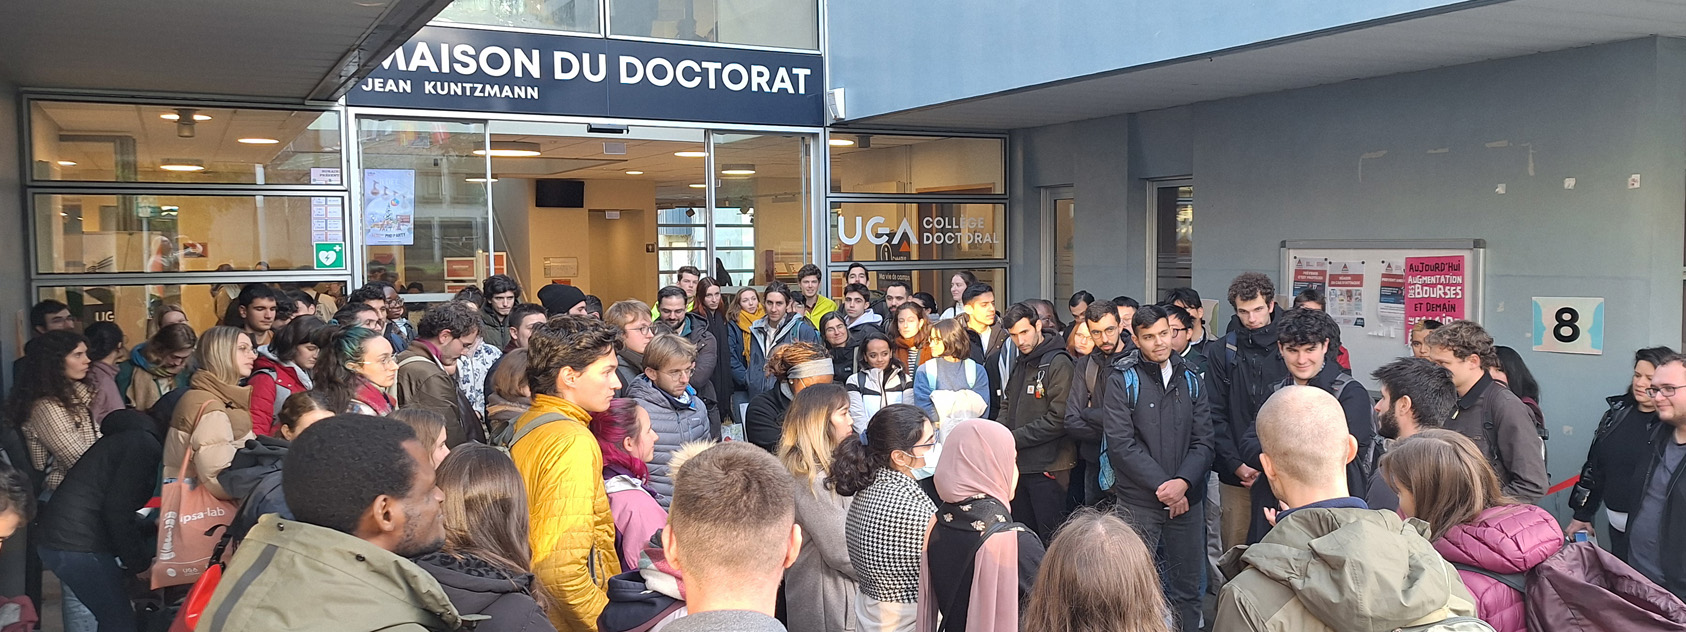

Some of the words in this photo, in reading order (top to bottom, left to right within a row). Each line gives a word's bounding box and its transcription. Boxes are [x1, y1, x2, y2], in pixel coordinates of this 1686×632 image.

[553, 50, 607, 83] DU
[618, 55, 812, 95] DOCTORAT
[361, 77, 412, 93] JEAN
[424, 80, 539, 100] KUNTZMANN
[838, 216, 919, 245] UGA
[922, 214, 985, 229] COLLÈGE
[923, 232, 999, 245] DOCTORAL
[1415, 284, 1462, 299] BOURSES
[1414, 303, 1424, 311] ET
[1553, 307, 1580, 343] 8
[180, 507, 225, 525] ipsa-lab
